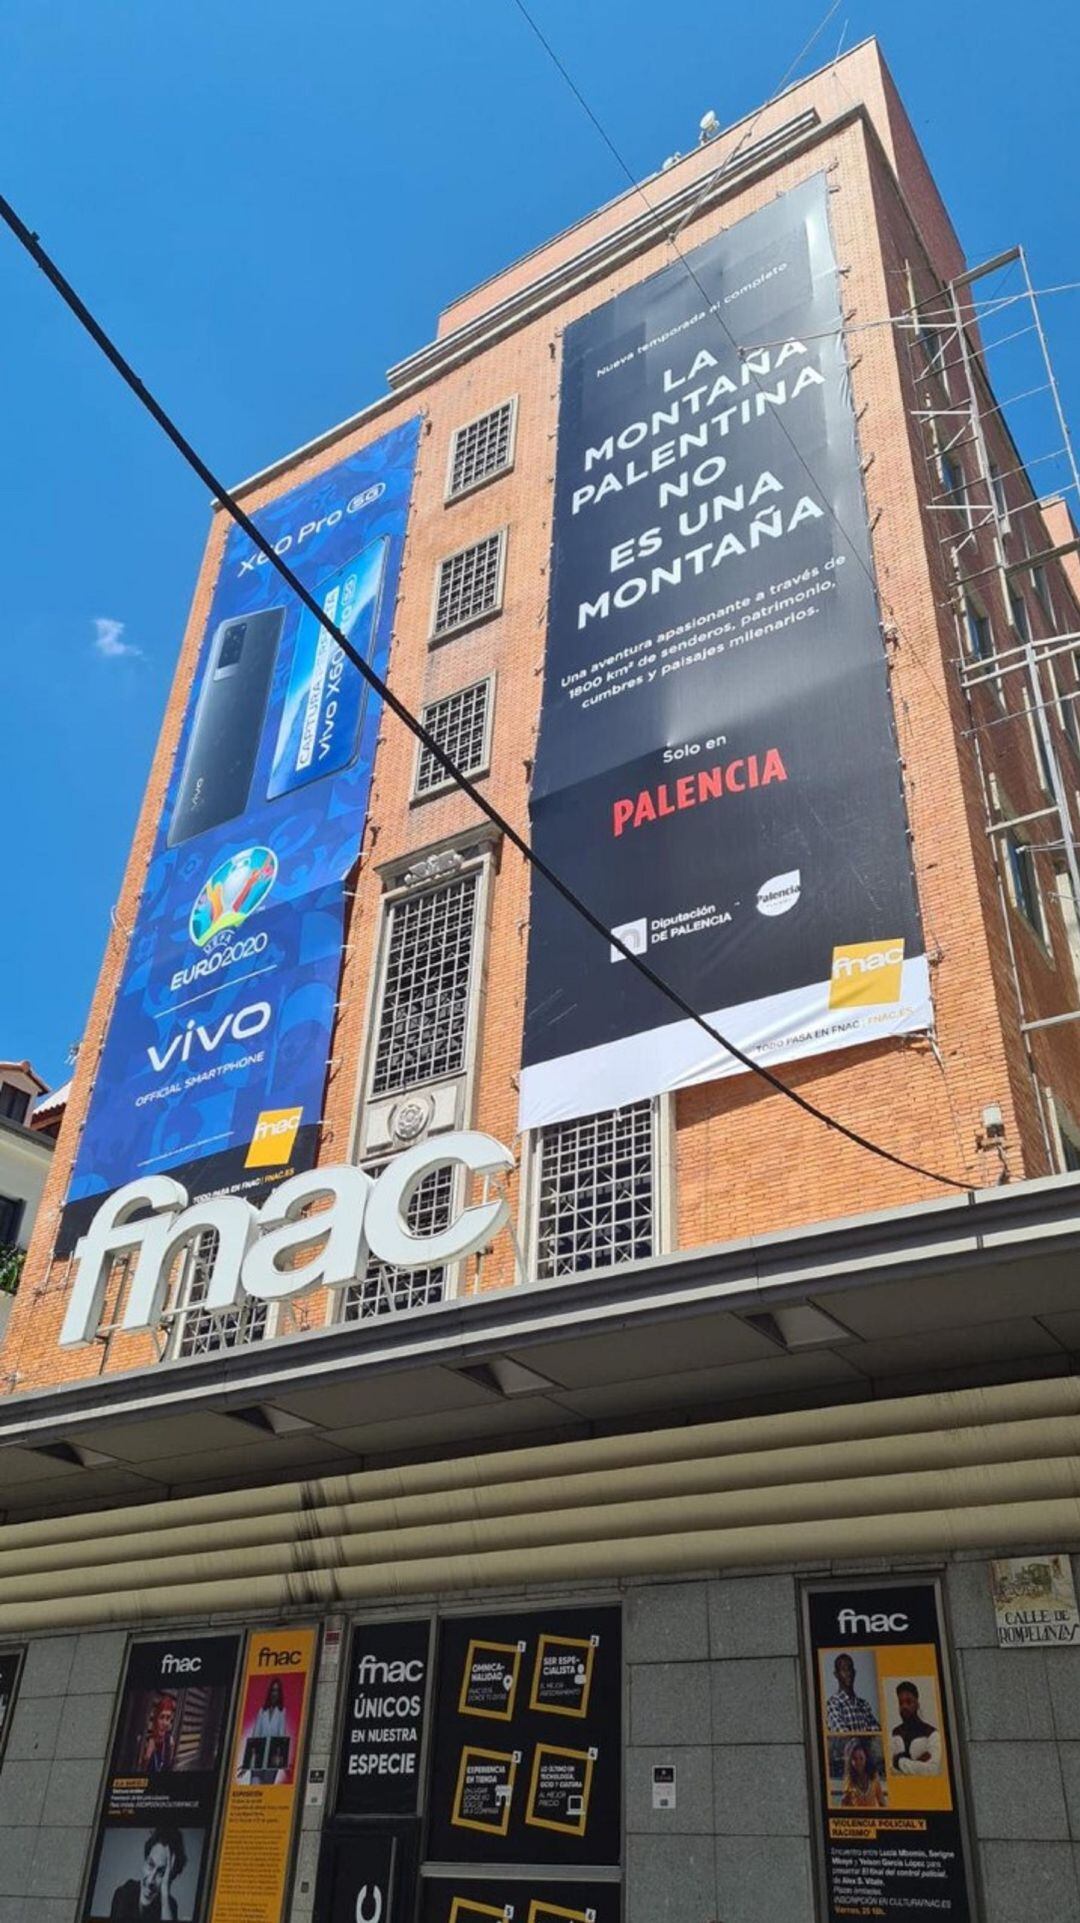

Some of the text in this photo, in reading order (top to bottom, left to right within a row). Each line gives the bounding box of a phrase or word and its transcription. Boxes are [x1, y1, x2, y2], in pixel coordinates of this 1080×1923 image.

[597, 352, 634, 378] Nueva
[637, 311, 706, 354] temporada
[724, 263, 787, 304] completo
[663, 349, 719, 393] LA
[584, 337, 808, 472] MONTAÑA
[571, 365, 826, 515] PALENTINA
[659, 456, 727, 509] NO
[297, 510, 343, 544] Pro
[610, 471, 784, 573] ES UNA
[577, 496, 824, 630] MONTAÑA
[561, 554, 846, 688] Una aventura apasionante a través de
[569, 676, 603, 699] 1800
[637, 653, 657, 669] de
[661, 622, 736, 658] senderos,
[741, 579, 836, 629] patrimonio,
[581, 607, 820, 709] cumbres y paisajes milenarios.
[318, 701, 338, 761] vivo
[663, 735, 727, 764] Solo en
[612, 747, 788, 838] PALENCIA
[651, 903, 716, 931] Diputación
[651, 911, 732, 945] DE PALENCIA
[170, 932, 268, 991] EURO2020
[833, 947, 904, 980] fnac
[146, 1001, 272, 1072] vivo
[814, 1027, 829, 1039] EN
[830, 1020, 861, 1034] FNAC
[135, 1051, 265, 1107] OFFICIAL SMARTPHONE
[58, 1131, 515, 1348] fnac
[837, 1607, 910, 1635] fnac
[1004, 1609, 1070, 1625] CALLE DE
[161, 1653, 202, 1674] fnac
[258, 1646, 302, 1668] fnac
[358, 1654, 424, 1685] fnac
[354, 1692, 421, 1719] ÚNICOS
[351, 1727, 418, 1743] EN NUESTRA
[348, 1753, 416, 1775] ESPECIE
